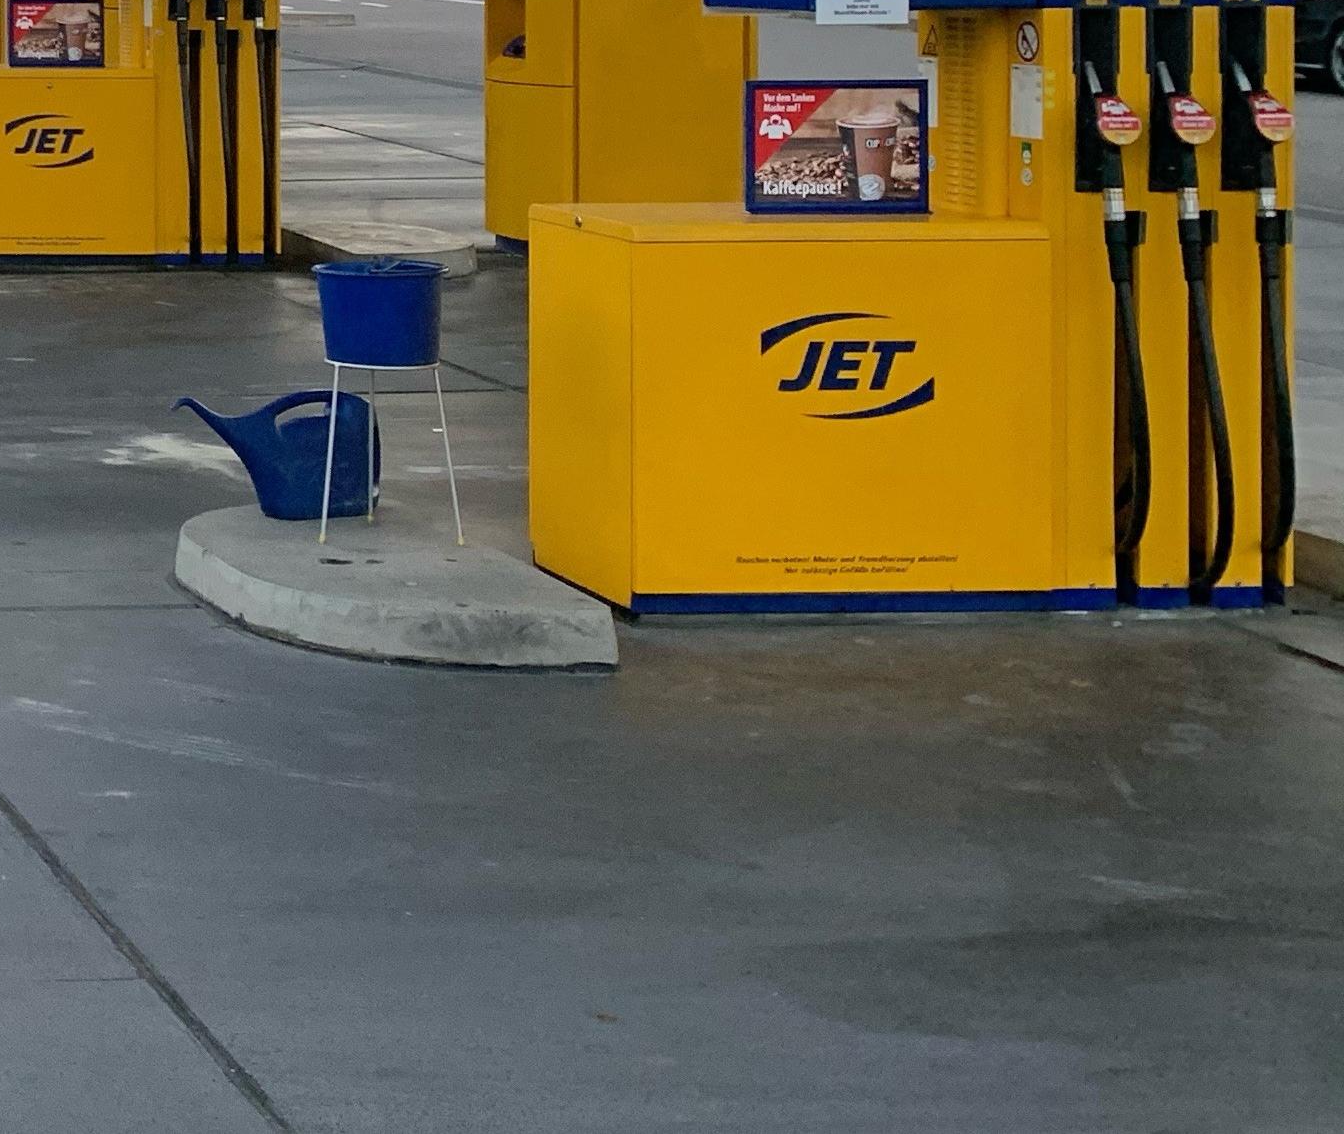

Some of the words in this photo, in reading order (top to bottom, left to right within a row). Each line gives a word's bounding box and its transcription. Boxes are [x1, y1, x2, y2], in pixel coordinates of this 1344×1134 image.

[14, 128, 86, 155] JET
[762, 181, 842, 198] Kaffeepause!
[777, 340, 917, 392] JET
